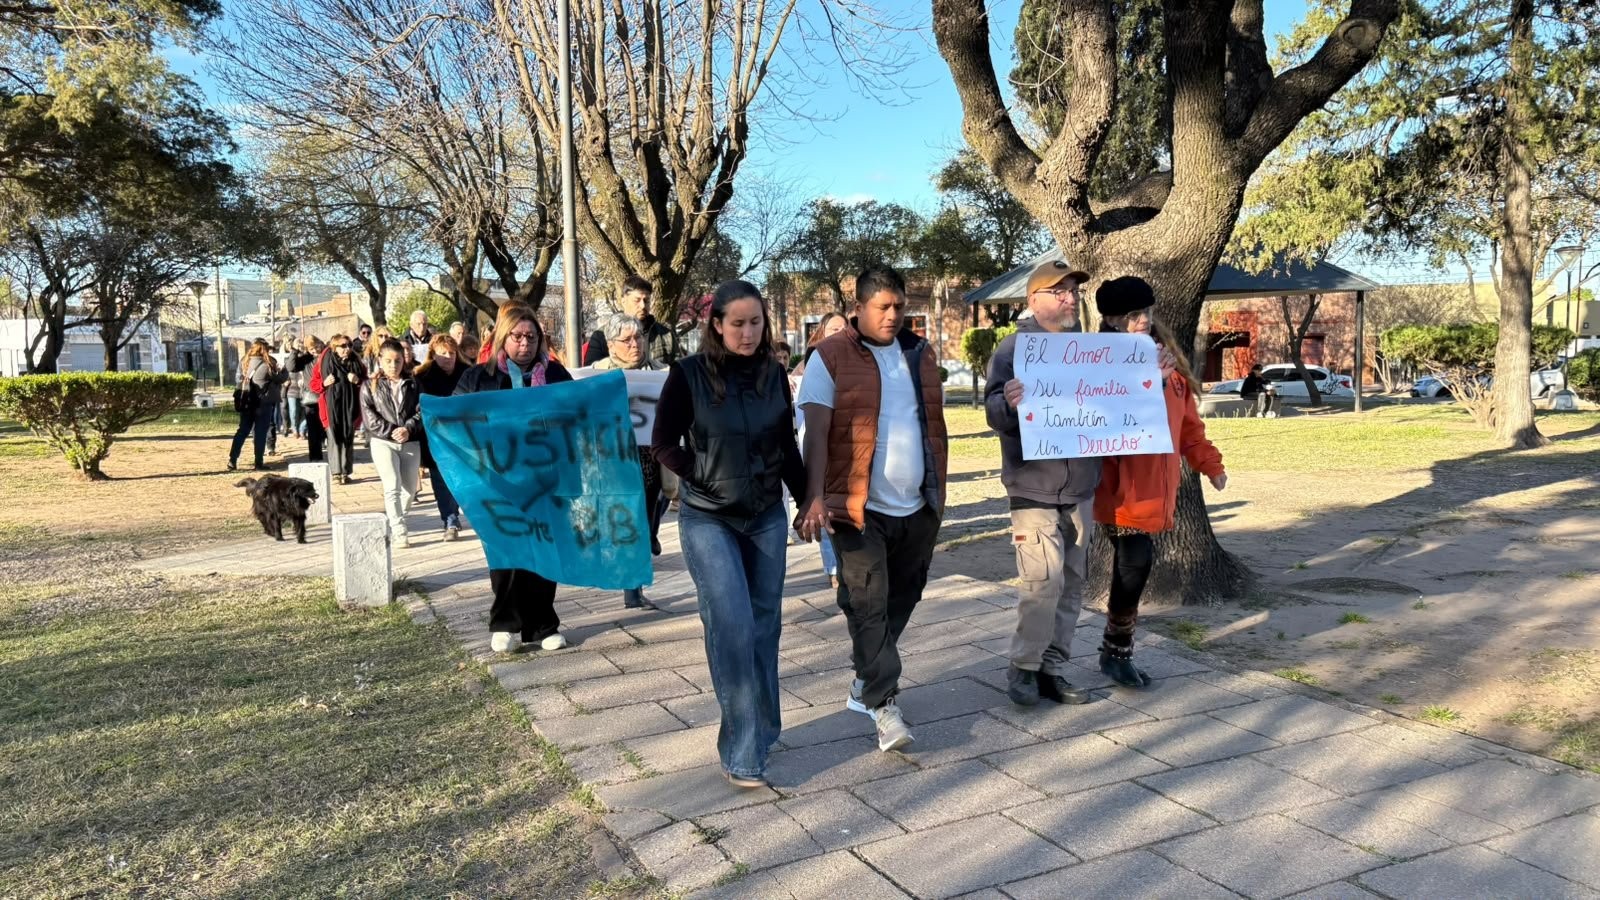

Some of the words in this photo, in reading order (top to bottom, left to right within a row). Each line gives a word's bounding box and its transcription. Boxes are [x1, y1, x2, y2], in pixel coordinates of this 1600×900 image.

[1024, 336, 1049, 372] El
[1062, 340, 1113, 365] Amor
[1122, 341, 1147, 364] de
[1032, 378, 1061, 397] su
[1075, 378, 1129, 406] familia
[1042, 405, 1108, 428] también
[1122, 412, 1138, 427] es
[1077, 433, 1142, 455] Derecho
